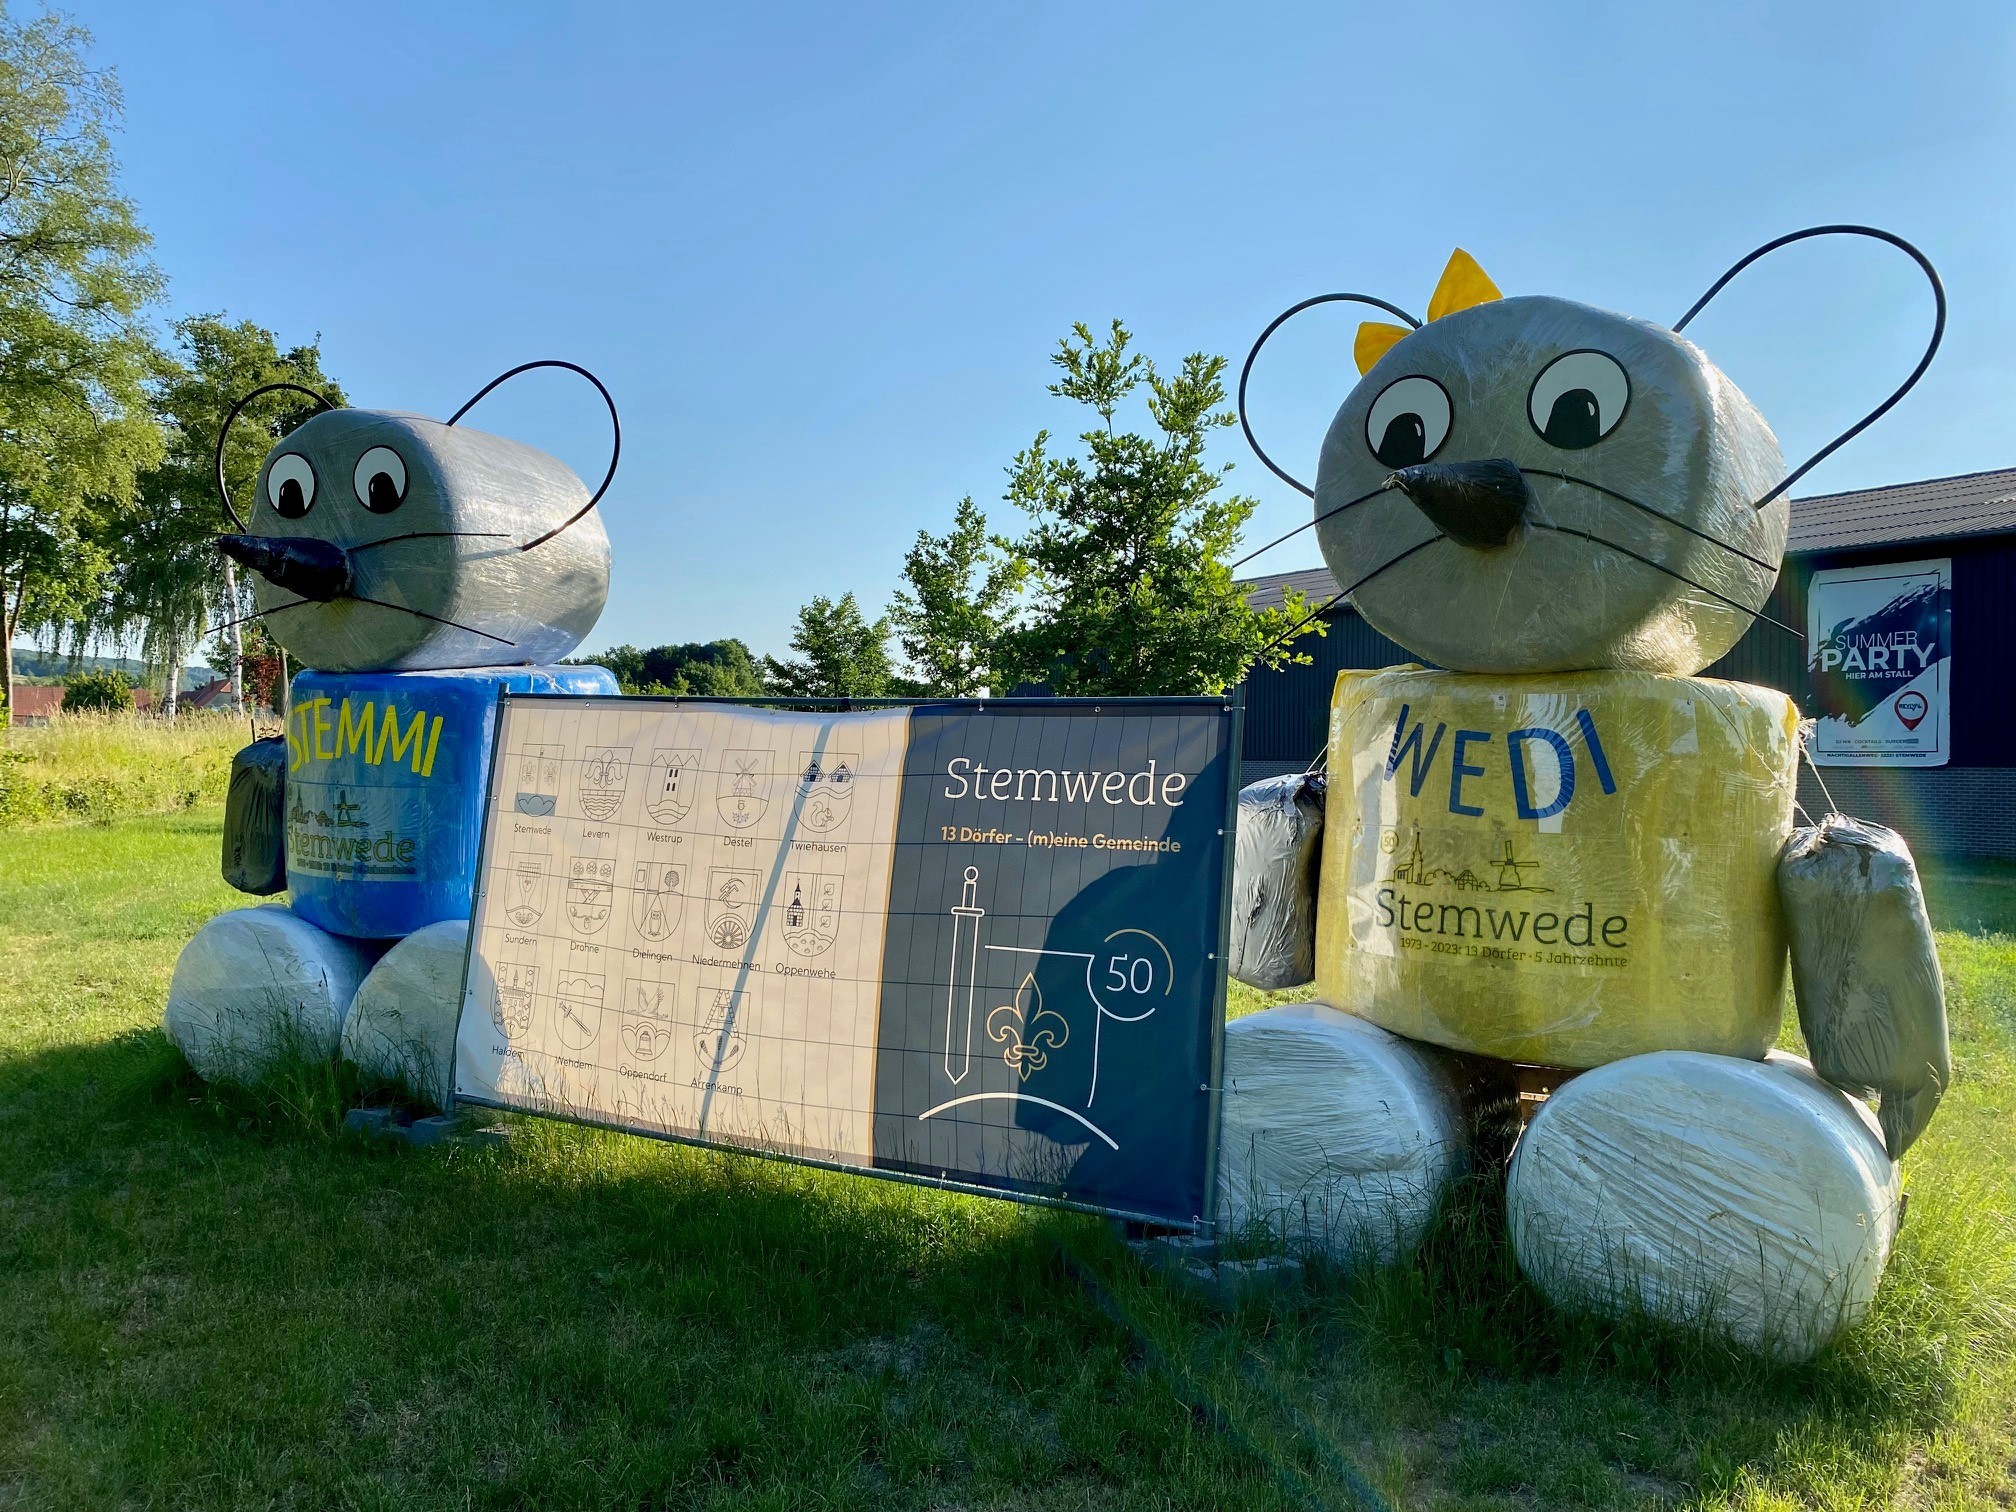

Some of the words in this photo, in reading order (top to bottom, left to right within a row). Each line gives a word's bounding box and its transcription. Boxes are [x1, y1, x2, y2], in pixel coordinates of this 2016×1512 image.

[1835, 630, 1918, 650] SUMMER
[1821, 643, 1936, 672] PARTY
[1845, 672, 1867, 680] HIER
[1868, 671, 1883, 679] AM
[1885, 670, 1914, 678] STALL
[287, 697, 444, 778] STEMMI
[1383, 703, 1619, 820] WEDI
[943, 756, 1188, 807] Stemwede
[513, 822, 552, 835] Stemwede
[582, 827, 610, 839] Levern
[287, 824, 416, 863] Stemwede
[646, 831, 683, 845] Westrup
[723, 836, 753, 848] Destel
[789, 839, 847, 853] Twiehausen
[940, 826, 956, 842] 13
[960, 826, 1013, 845] Dörfer
[1027, 829, 1088, 849] (m)eine
[1092, 833, 1182, 853] Gemeinde
[1375, 888, 1629, 948] Stemwede
[504, 933, 538, 946] Sundern
[570, 941, 600, 954] Drohne
[632, 948, 673, 963] Dielingen
[1400, 937, 1422, 950] 1973
[1431, 941, 1462, 955] 2023:
[1465, 944, 1478, 957] 13
[1482, 945, 1526, 961] Dörfer
[1535, 952, 1543, 963] 5
[1546, 952, 1628, 968] Jahrzehnte
[691, 954, 761, 971] Niedermehnen
[775, 962, 837, 979] Oppenwehe
[1105, 953, 1153, 995] 50
[491, 1045, 525, 1058] Haldem
[555, 1055, 593, 1070] Wehdem
[619, 1065, 667, 1082] Oppendorf
[690, 1077, 743, 1096] Arrenkamp
